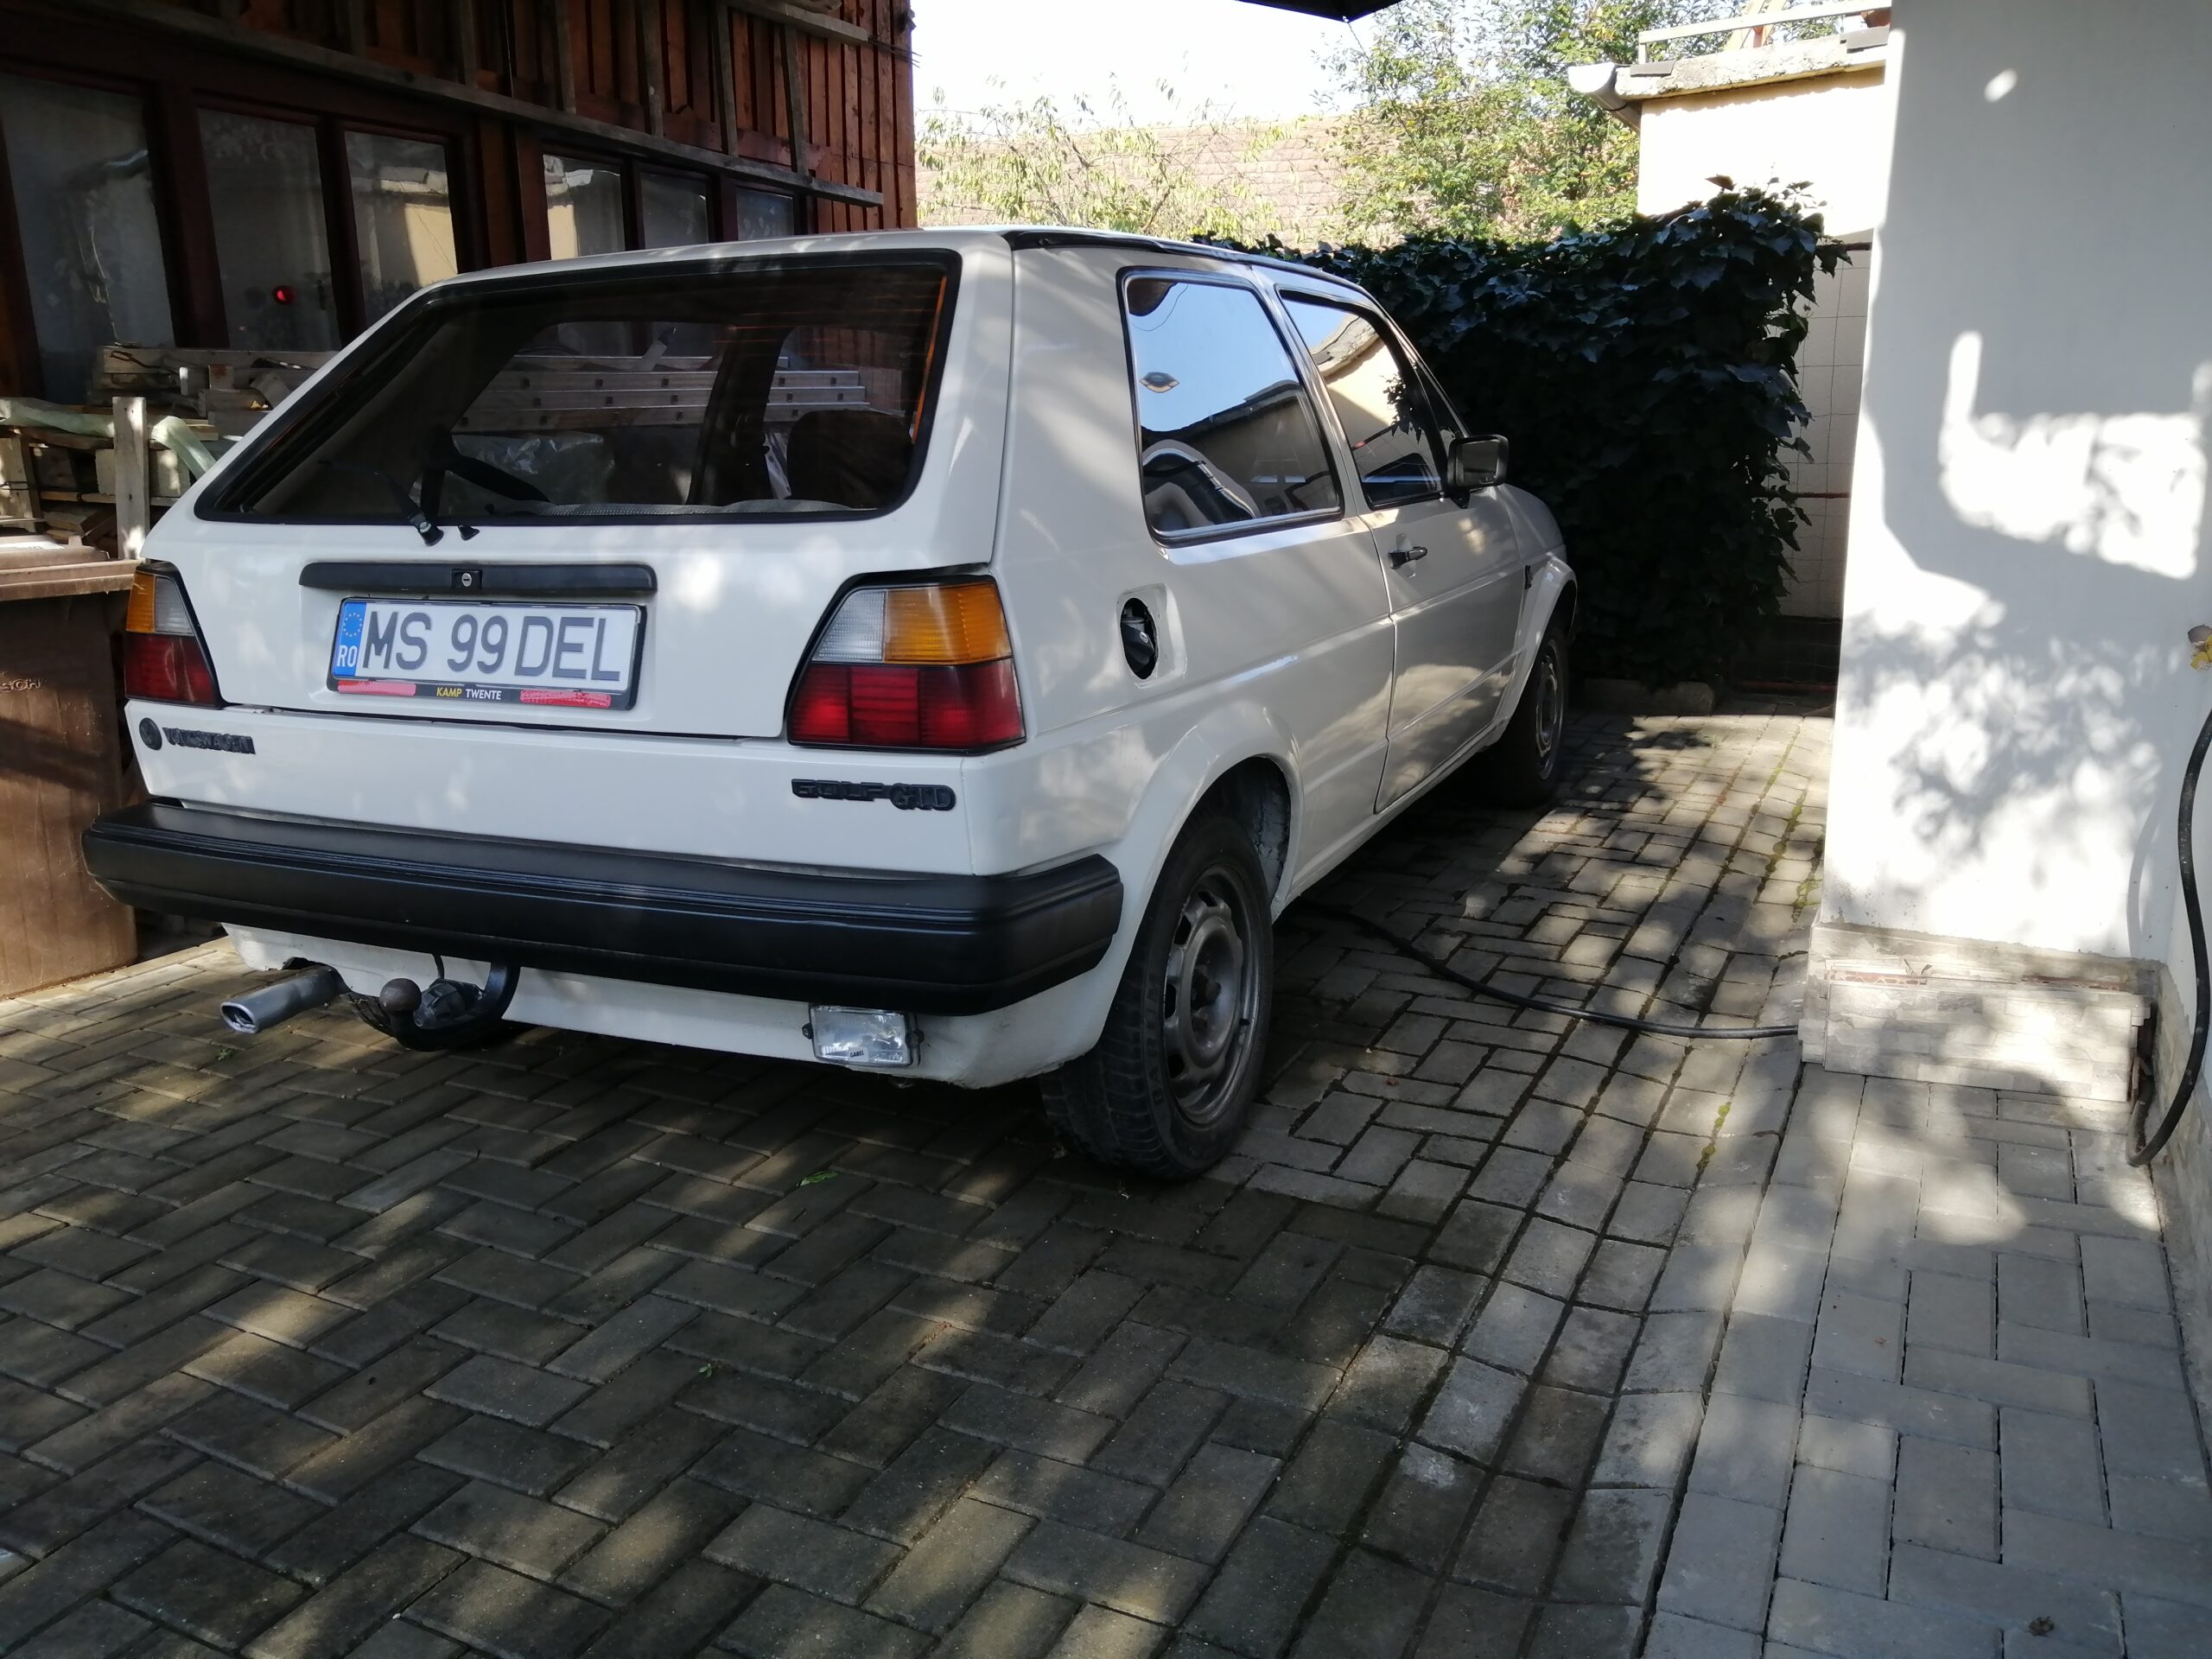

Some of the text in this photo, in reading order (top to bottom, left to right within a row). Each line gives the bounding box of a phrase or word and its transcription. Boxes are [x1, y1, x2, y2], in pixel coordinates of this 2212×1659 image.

[336, 645, 359, 669] RO
[362, 611, 621, 682] MS 99 DEL
[436, 687, 502, 700] KAMP TWENTE
